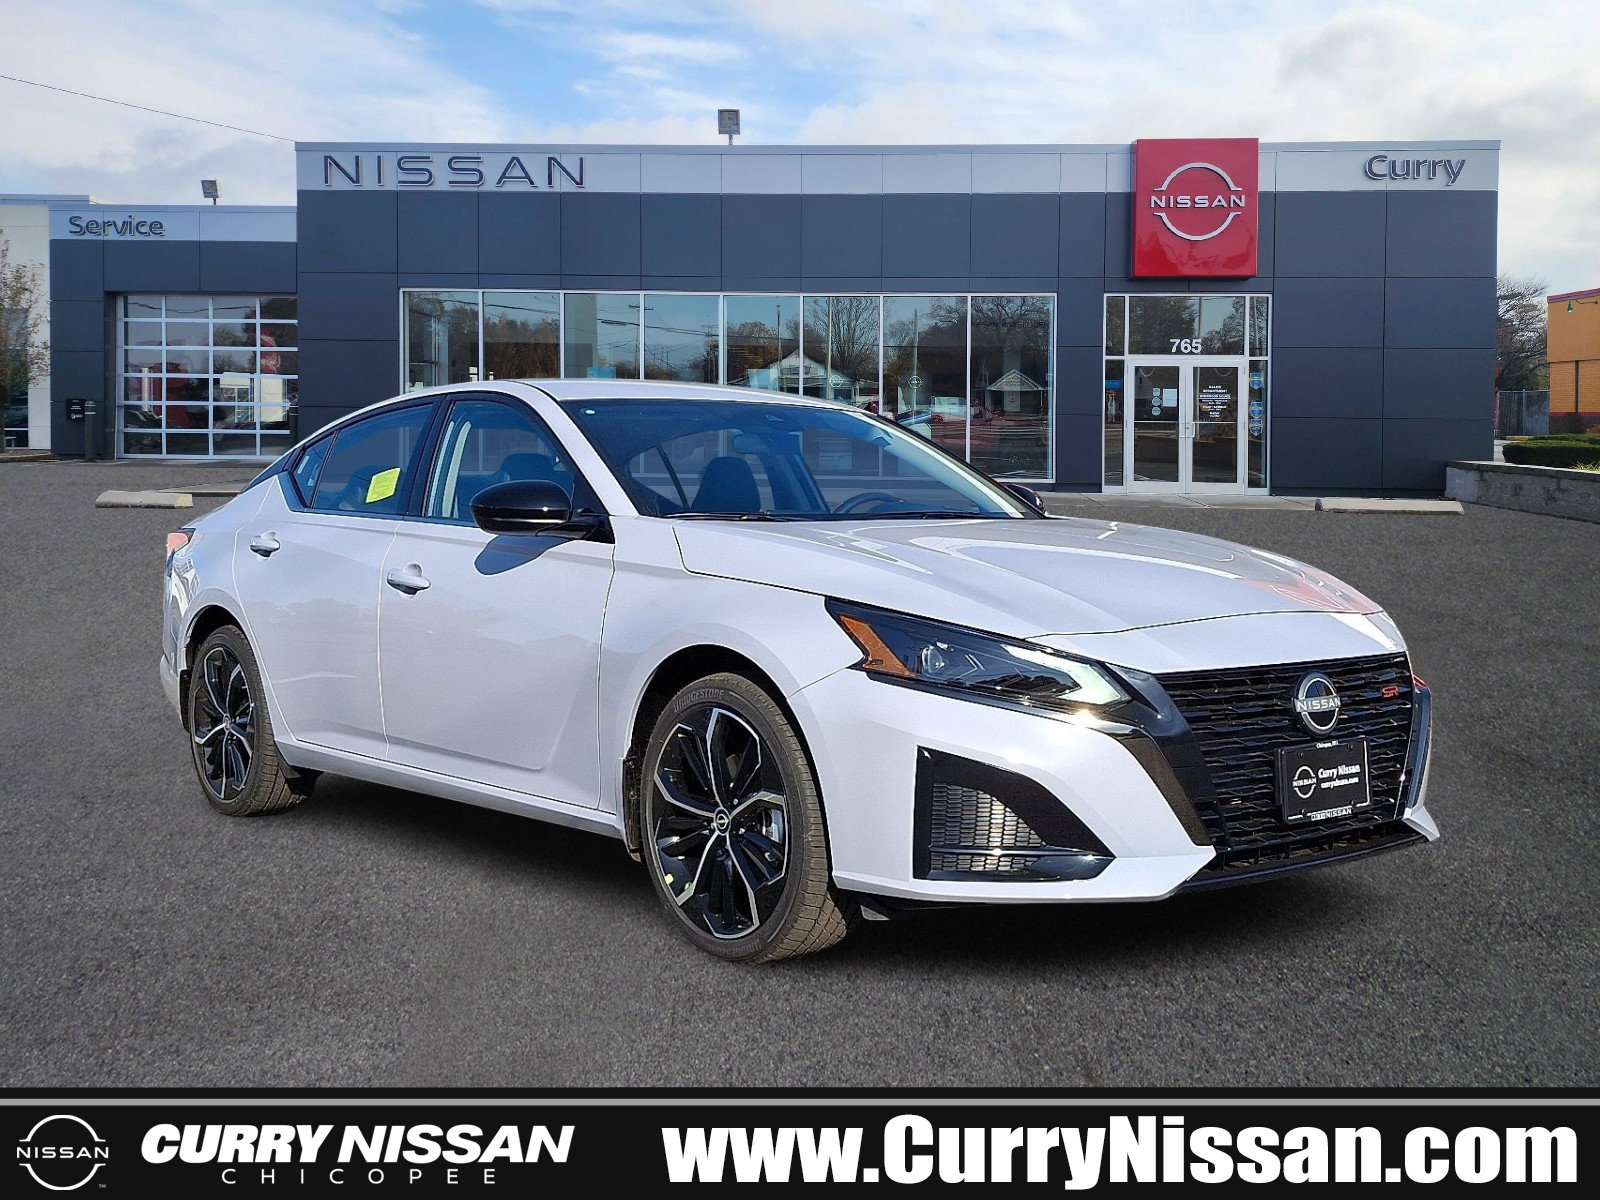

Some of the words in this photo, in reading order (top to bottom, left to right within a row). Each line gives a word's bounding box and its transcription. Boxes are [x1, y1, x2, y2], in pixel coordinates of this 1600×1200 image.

[323, 155, 585, 188] NISSAN
[1364, 154, 1466, 186] Curry
[1150, 194, 1245, 208] NISSAN
[68, 214, 165, 236] Service
[1169, 338, 1202, 354] 765
[1382, 686, 1398, 698] SR
[1296, 696, 1342, 711] NISSAN
[1318, 768, 1338, 778] Curry
[1338, 765, 1360, 775] Nissan
[1292, 778, 1316, 787] NISSAN
